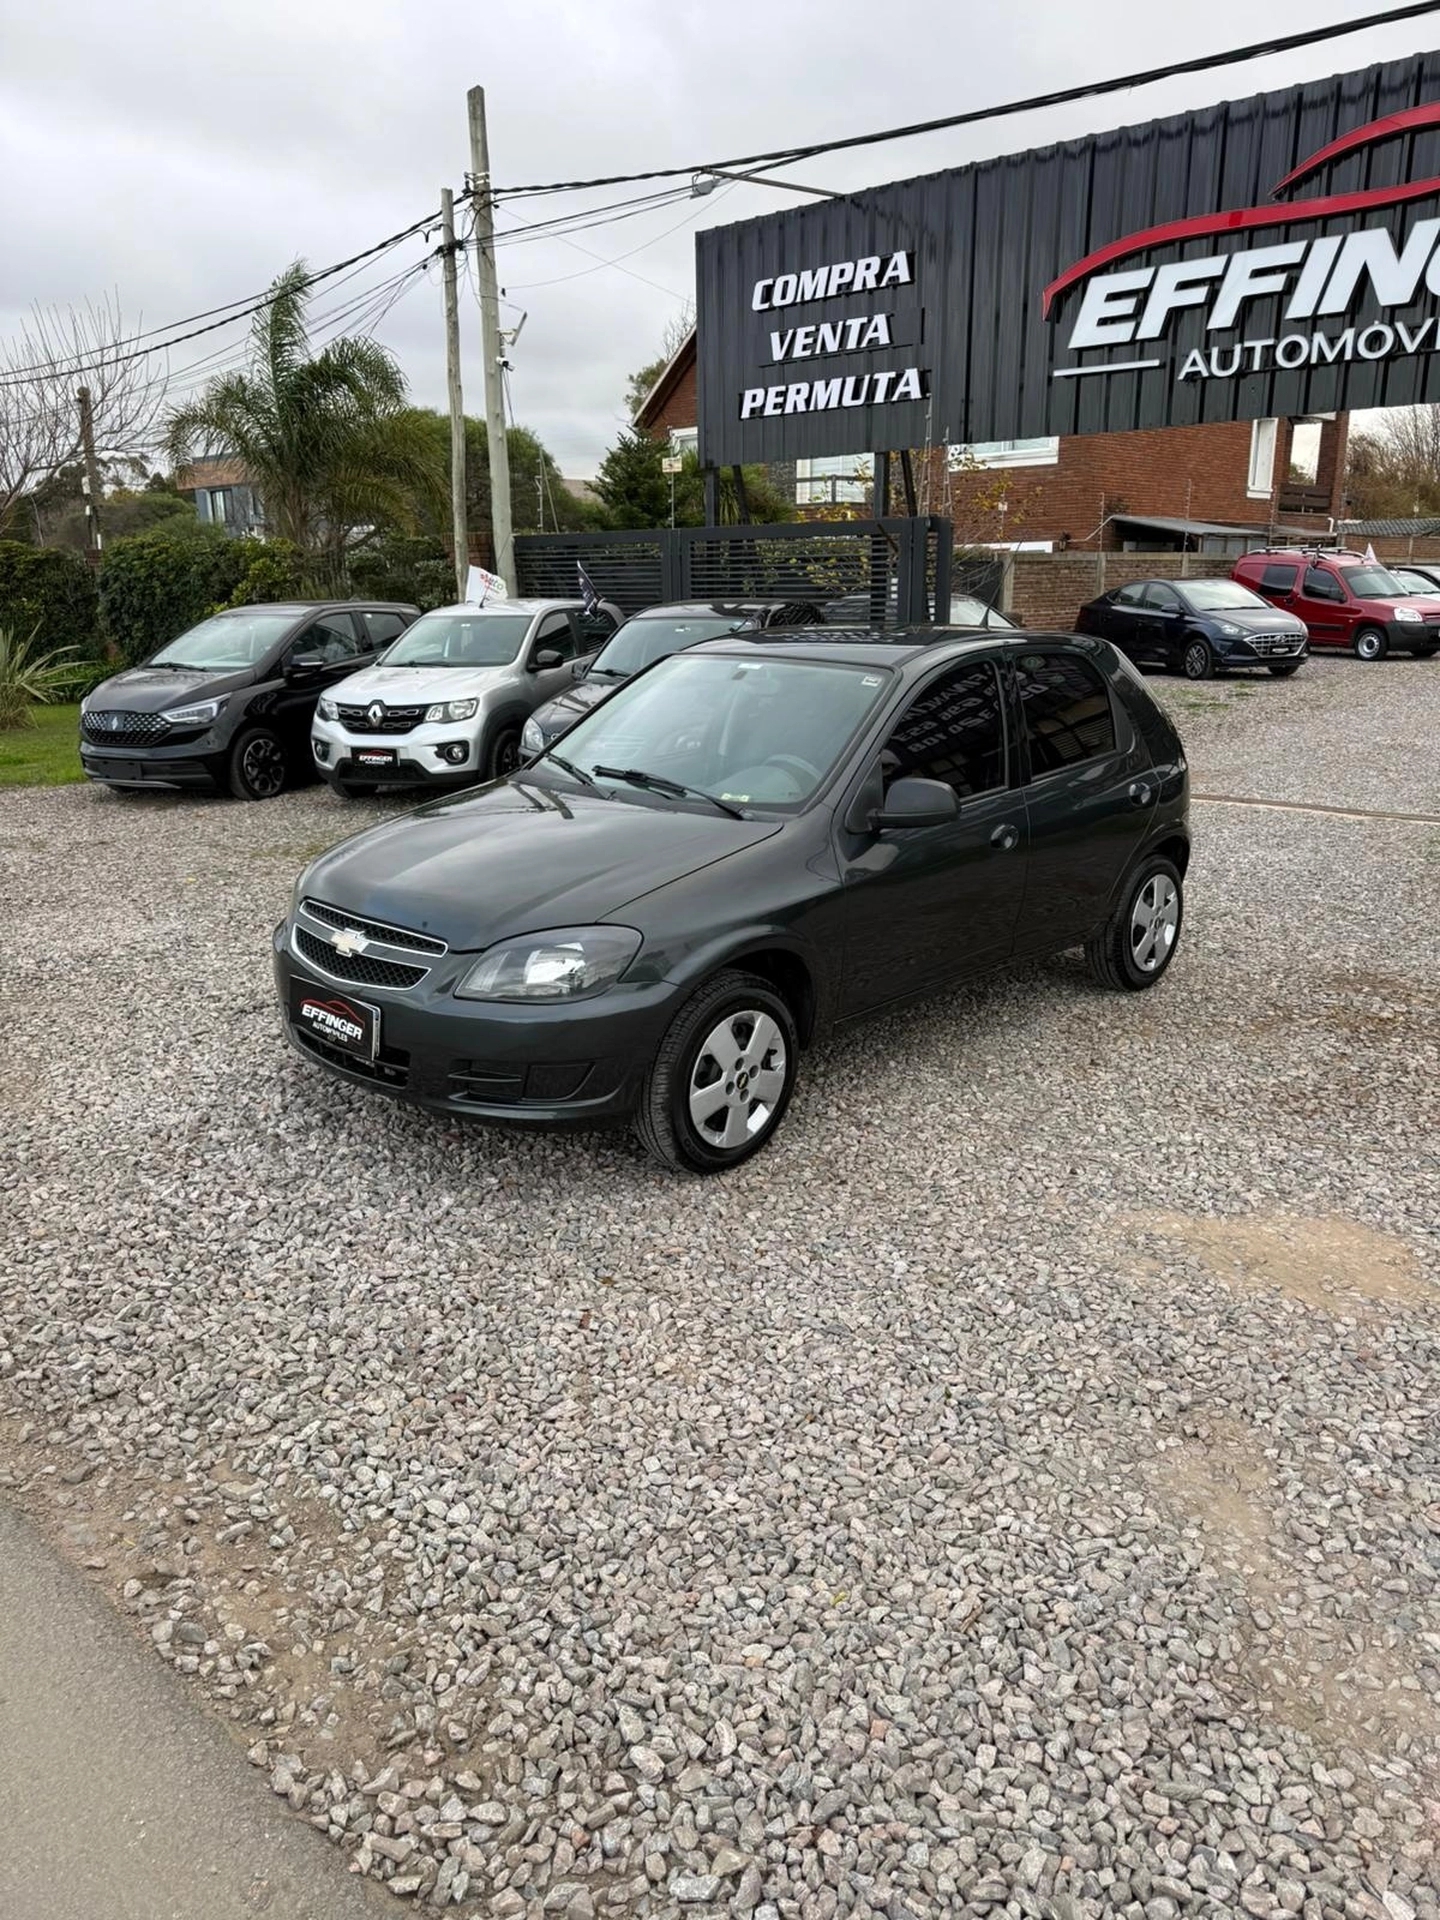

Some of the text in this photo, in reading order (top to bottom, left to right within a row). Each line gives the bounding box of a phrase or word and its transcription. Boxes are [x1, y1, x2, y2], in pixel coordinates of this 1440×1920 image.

[751, 250, 911, 312] COMPRA
[1068, 217, 1440, 349] EFFIN
[770, 313, 891, 362] VENTA
[740, 367, 923, 419] PERMUTA
[301, 1004, 363, 1040] EFFINGER
